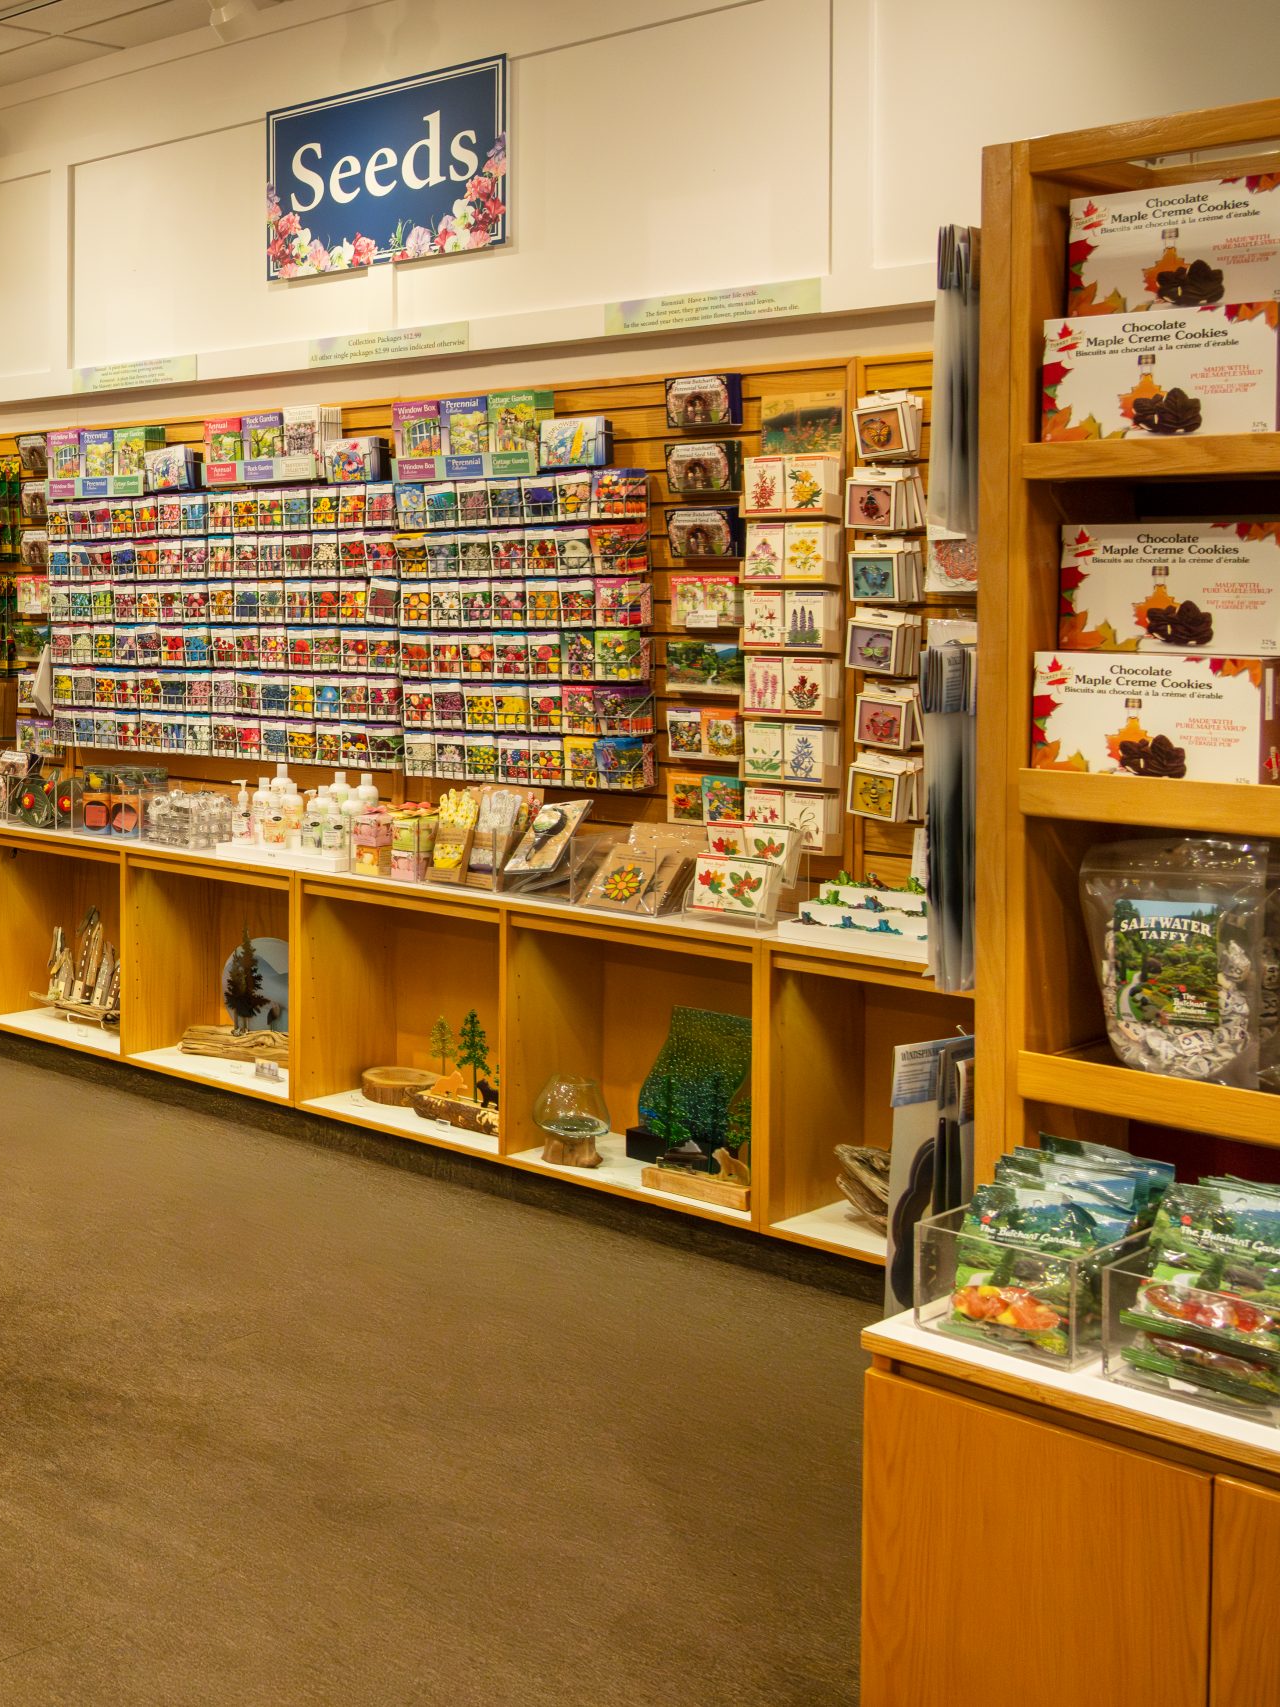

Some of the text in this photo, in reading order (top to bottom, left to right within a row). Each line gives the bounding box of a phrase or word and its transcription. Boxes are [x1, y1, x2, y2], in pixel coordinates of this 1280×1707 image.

[291, 110, 478, 212] Seeds
[1146, 194, 1209, 209] Chocolate
[1111, 200, 1249, 224] Maple Creme Cookies
[1101, 225, 1130, 234] Biscuits
[1145, 219, 1179, 228] chocolat
[1198, 213, 1223, 222] crème
[1226, 209, 1261, 219] d'érable
[1122, 321, 1186, 333] Chocolate
[348, 338, 376, 346] Collection
[1087, 329, 1228, 347] Maple Creme Cookies
[350, 350, 373, 359] packages
[410, 342, 435, 351] indicated
[437, 339, 465, 347] otherwise
[1121, 345, 1155, 354] chocolat
[1204, 339, 1239, 347] d'érable
[398, 406, 422, 414] Window
[446, 400, 478, 408] Perennial
[259, 415, 278, 423] Garden
[1137, 534, 1199, 544] Chocolate
[1102, 545, 1139, 556] Maple
[1143, 545, 1183, 554] Creme
[1188, 545, 1239, 554] Cookies
[1110, 665, 1172, 676] Chocolate
[1075, 675, 1213, 689] Maple Creme Cookies
[1189, 691, 1223, 699] d'érable
[1121, 917, 1212, 937] SALTWATER
[1140, 931, 1189, 942] TAFFY
[980, 1224, 1081, 1247] The Butchart Gardens
[1181, 1225, 1199, 1237] The
[1201, 1229, 1251, 1247] Butchart
